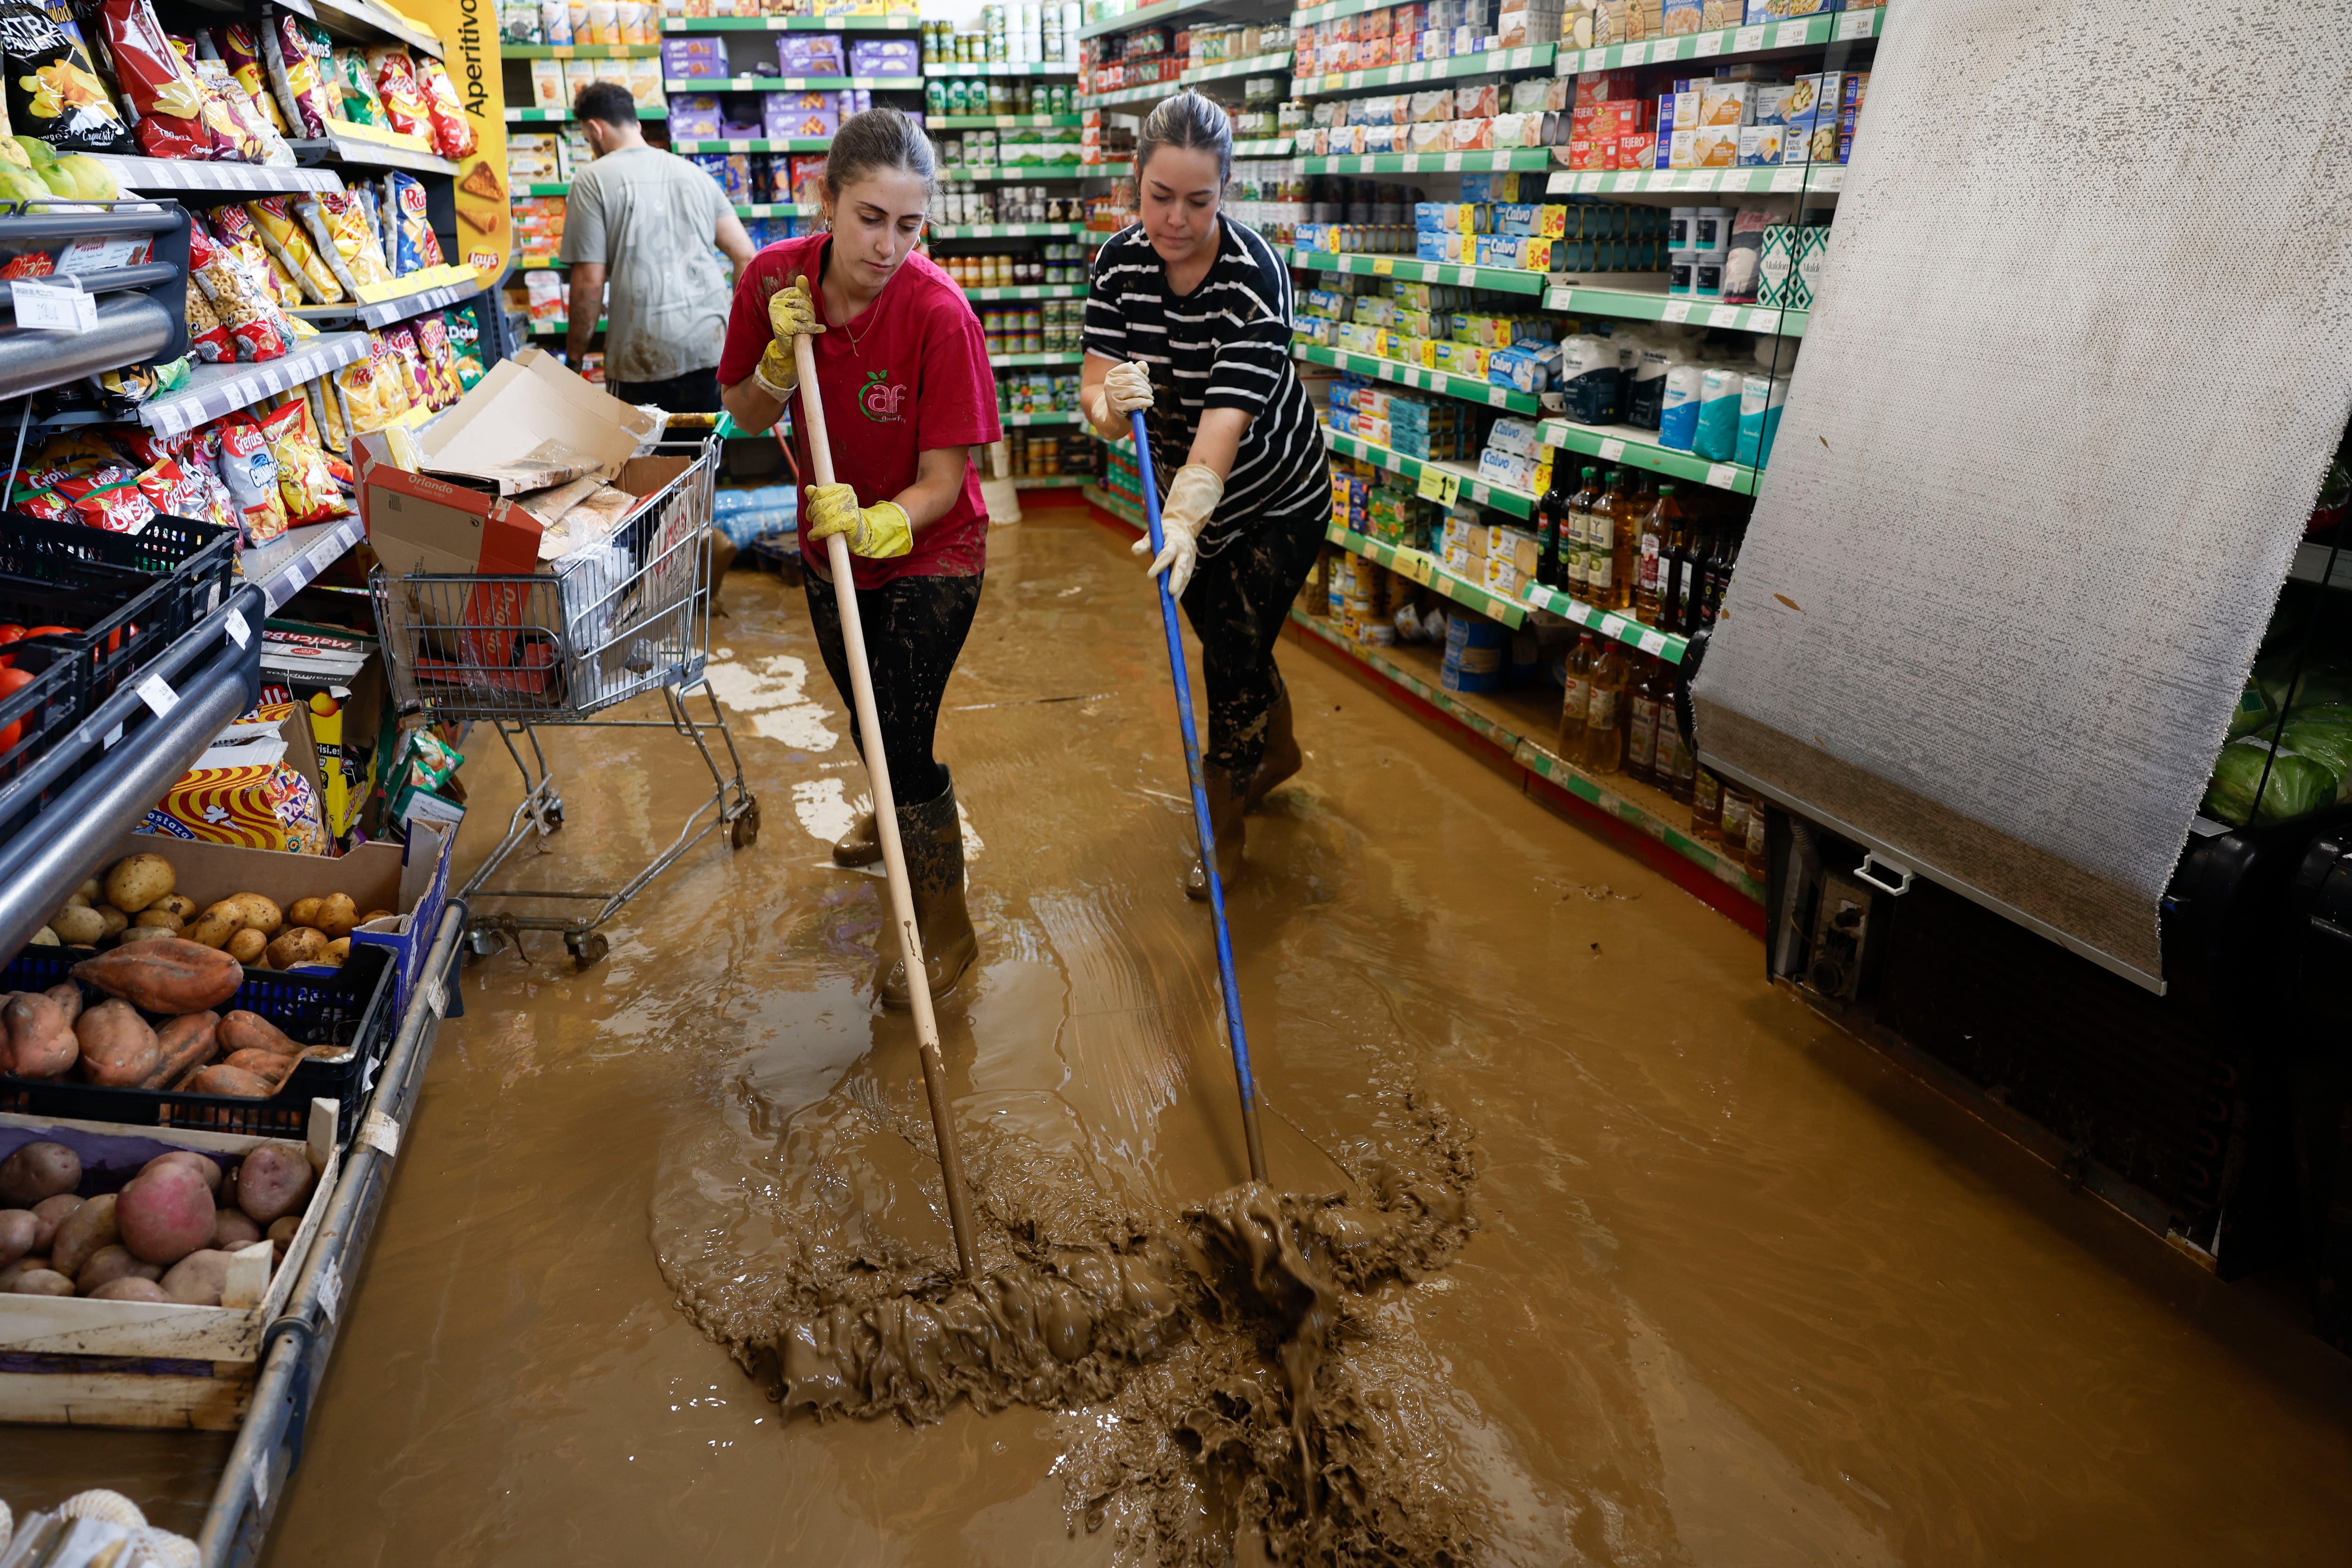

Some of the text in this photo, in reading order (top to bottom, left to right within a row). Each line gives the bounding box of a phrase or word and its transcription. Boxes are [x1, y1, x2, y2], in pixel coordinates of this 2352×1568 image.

[458, 0, 488, 118] Aperitivo
[1621, 136, 1645, 150] TEJERO
[1506, 207, 1530, 222] Calvo
[1491, 239, 1516, 255] Calvo
[469, 251, 499, 270] Lay's
[1765, 260, 1789, 271] Maldon
[1490, 355, 1512, 373] Calvo
[1494, 421, 1520, 438] Calvo
[1484, 451, 1510, 470] Calvo
[408, 475, 453, 494] Orlando
